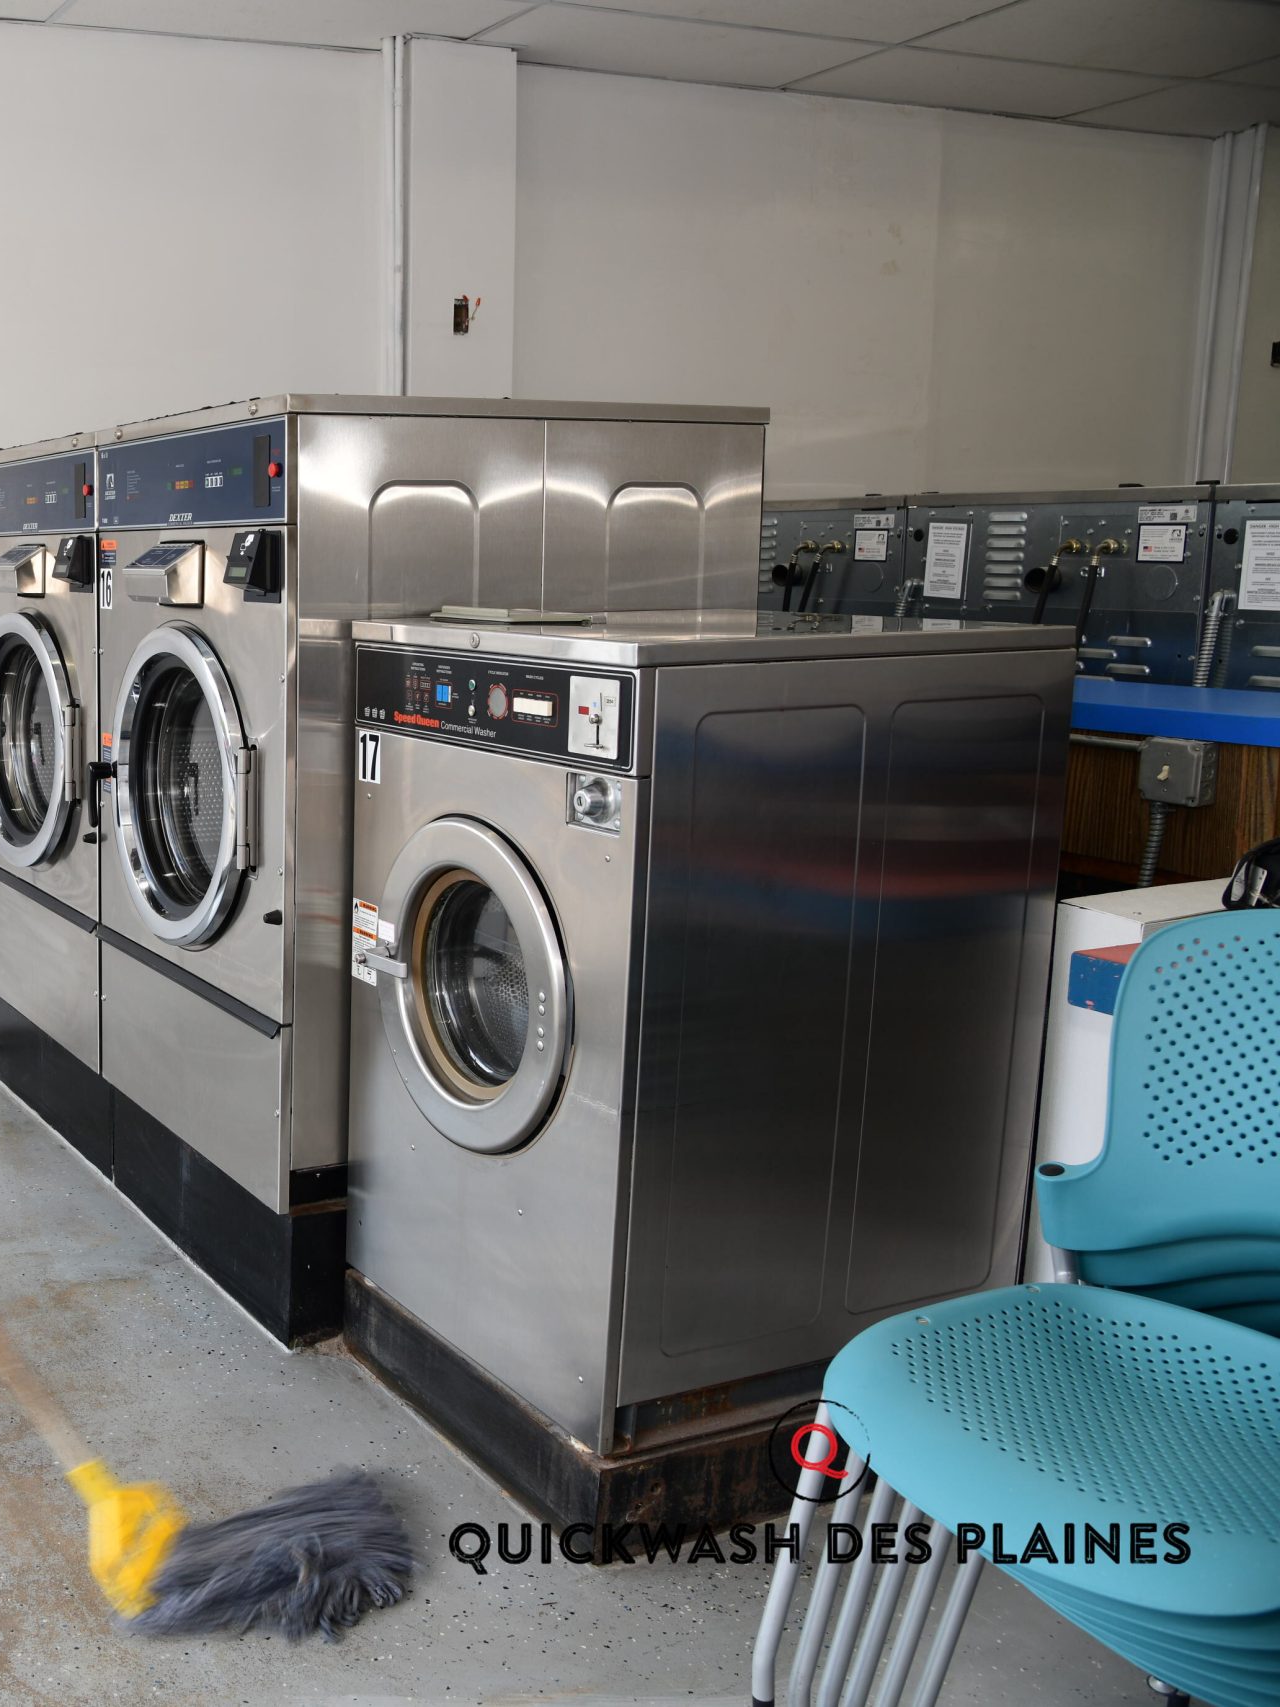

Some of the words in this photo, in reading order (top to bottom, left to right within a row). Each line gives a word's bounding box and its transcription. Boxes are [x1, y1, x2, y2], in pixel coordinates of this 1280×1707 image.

[168, 513, 193, 522] DEXTER
[100, 570, 112, 607] 16
[394, 710, 416, 724] Speed
[416, 714, 440, 728] Queen
[440, 720, 474, 735] Commercial
[474, 727, 497, 738] Washer
[360, 733, 380, 781] 17
